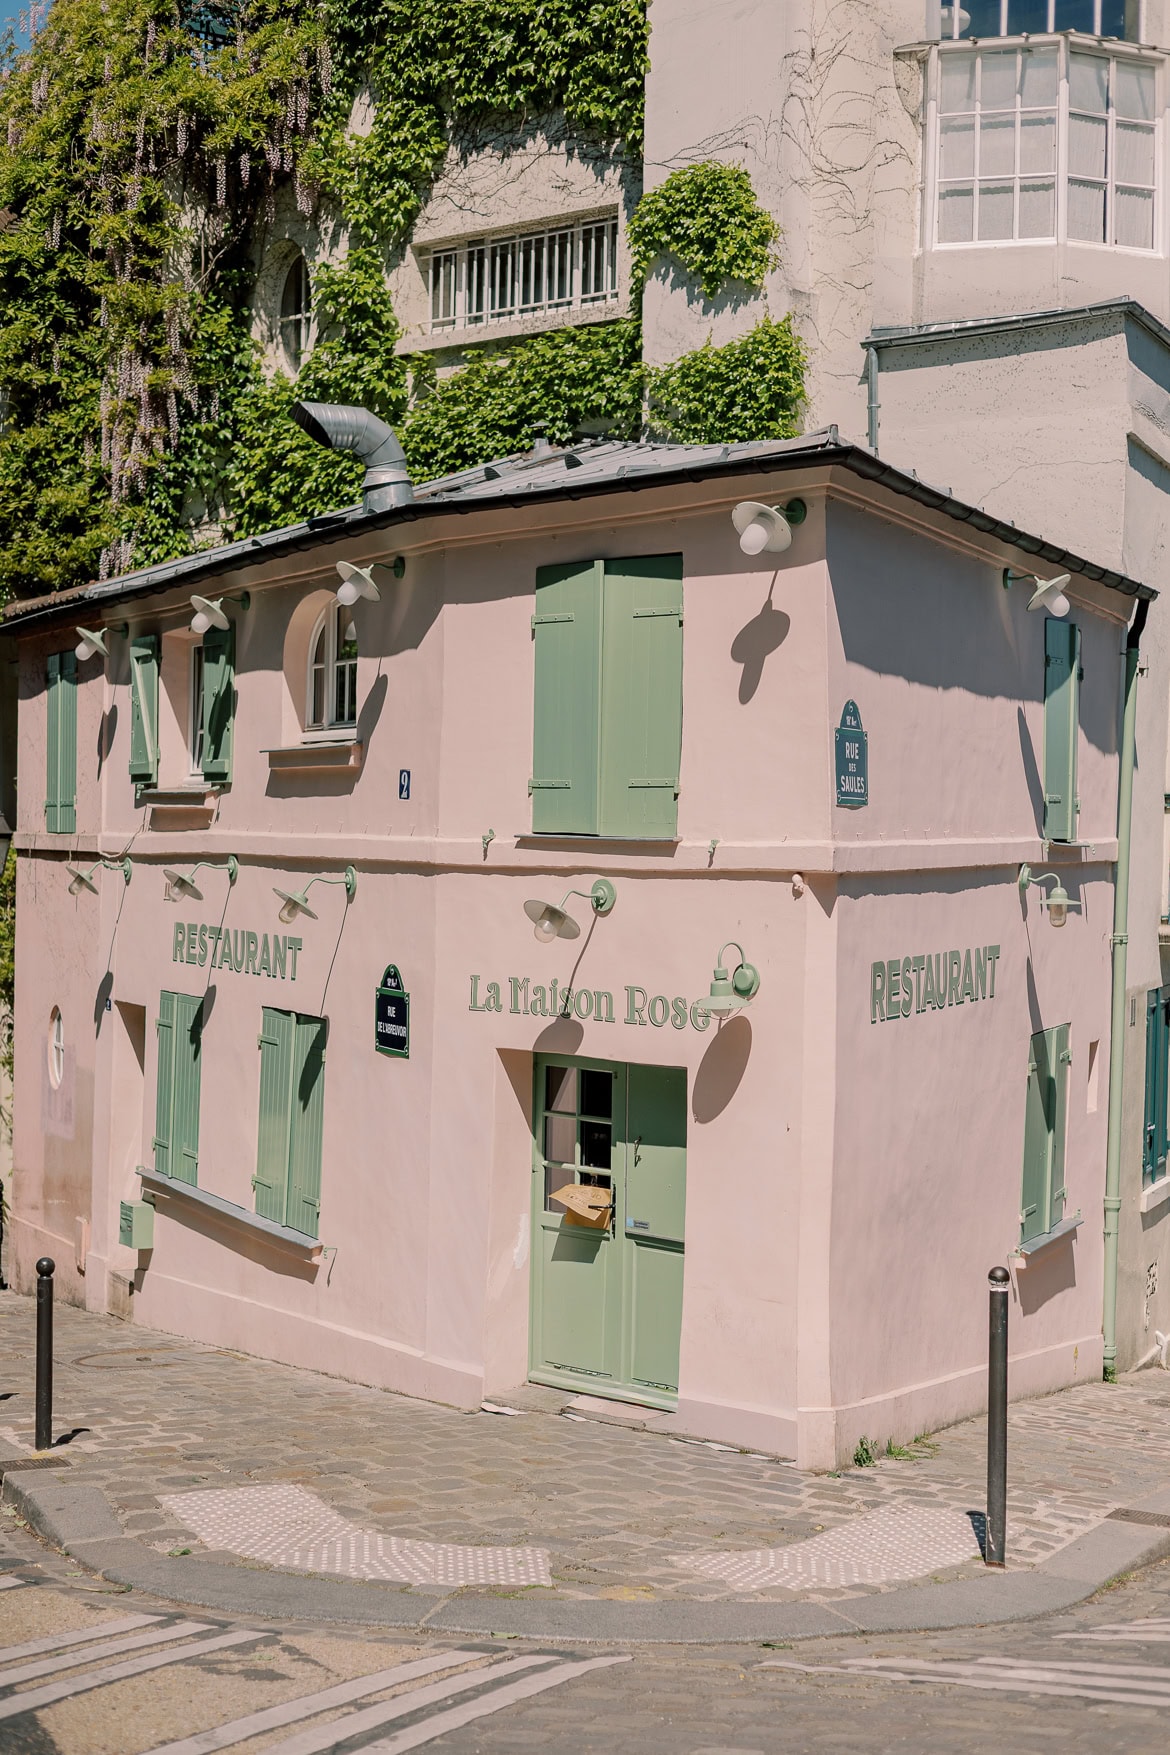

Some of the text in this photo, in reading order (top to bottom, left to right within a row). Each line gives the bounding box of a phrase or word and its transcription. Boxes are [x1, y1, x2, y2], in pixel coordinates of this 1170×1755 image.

[845, 742, 860, 760] RUE
[848, 762, 857, 772] DES
[401, 771, 409, 799] 2
[840, 775, 865, 793] SAULES
[172, 922, 303, 981] RESTAURANT
[870, 944, 1001, 1025] RESTAURANT
[468, 974, 503, 1013] La
[508, 976, 616, 1023] Maison
[387, 1005, 396, 1018] RUE
[377, 1021, 383, 1033] DE
